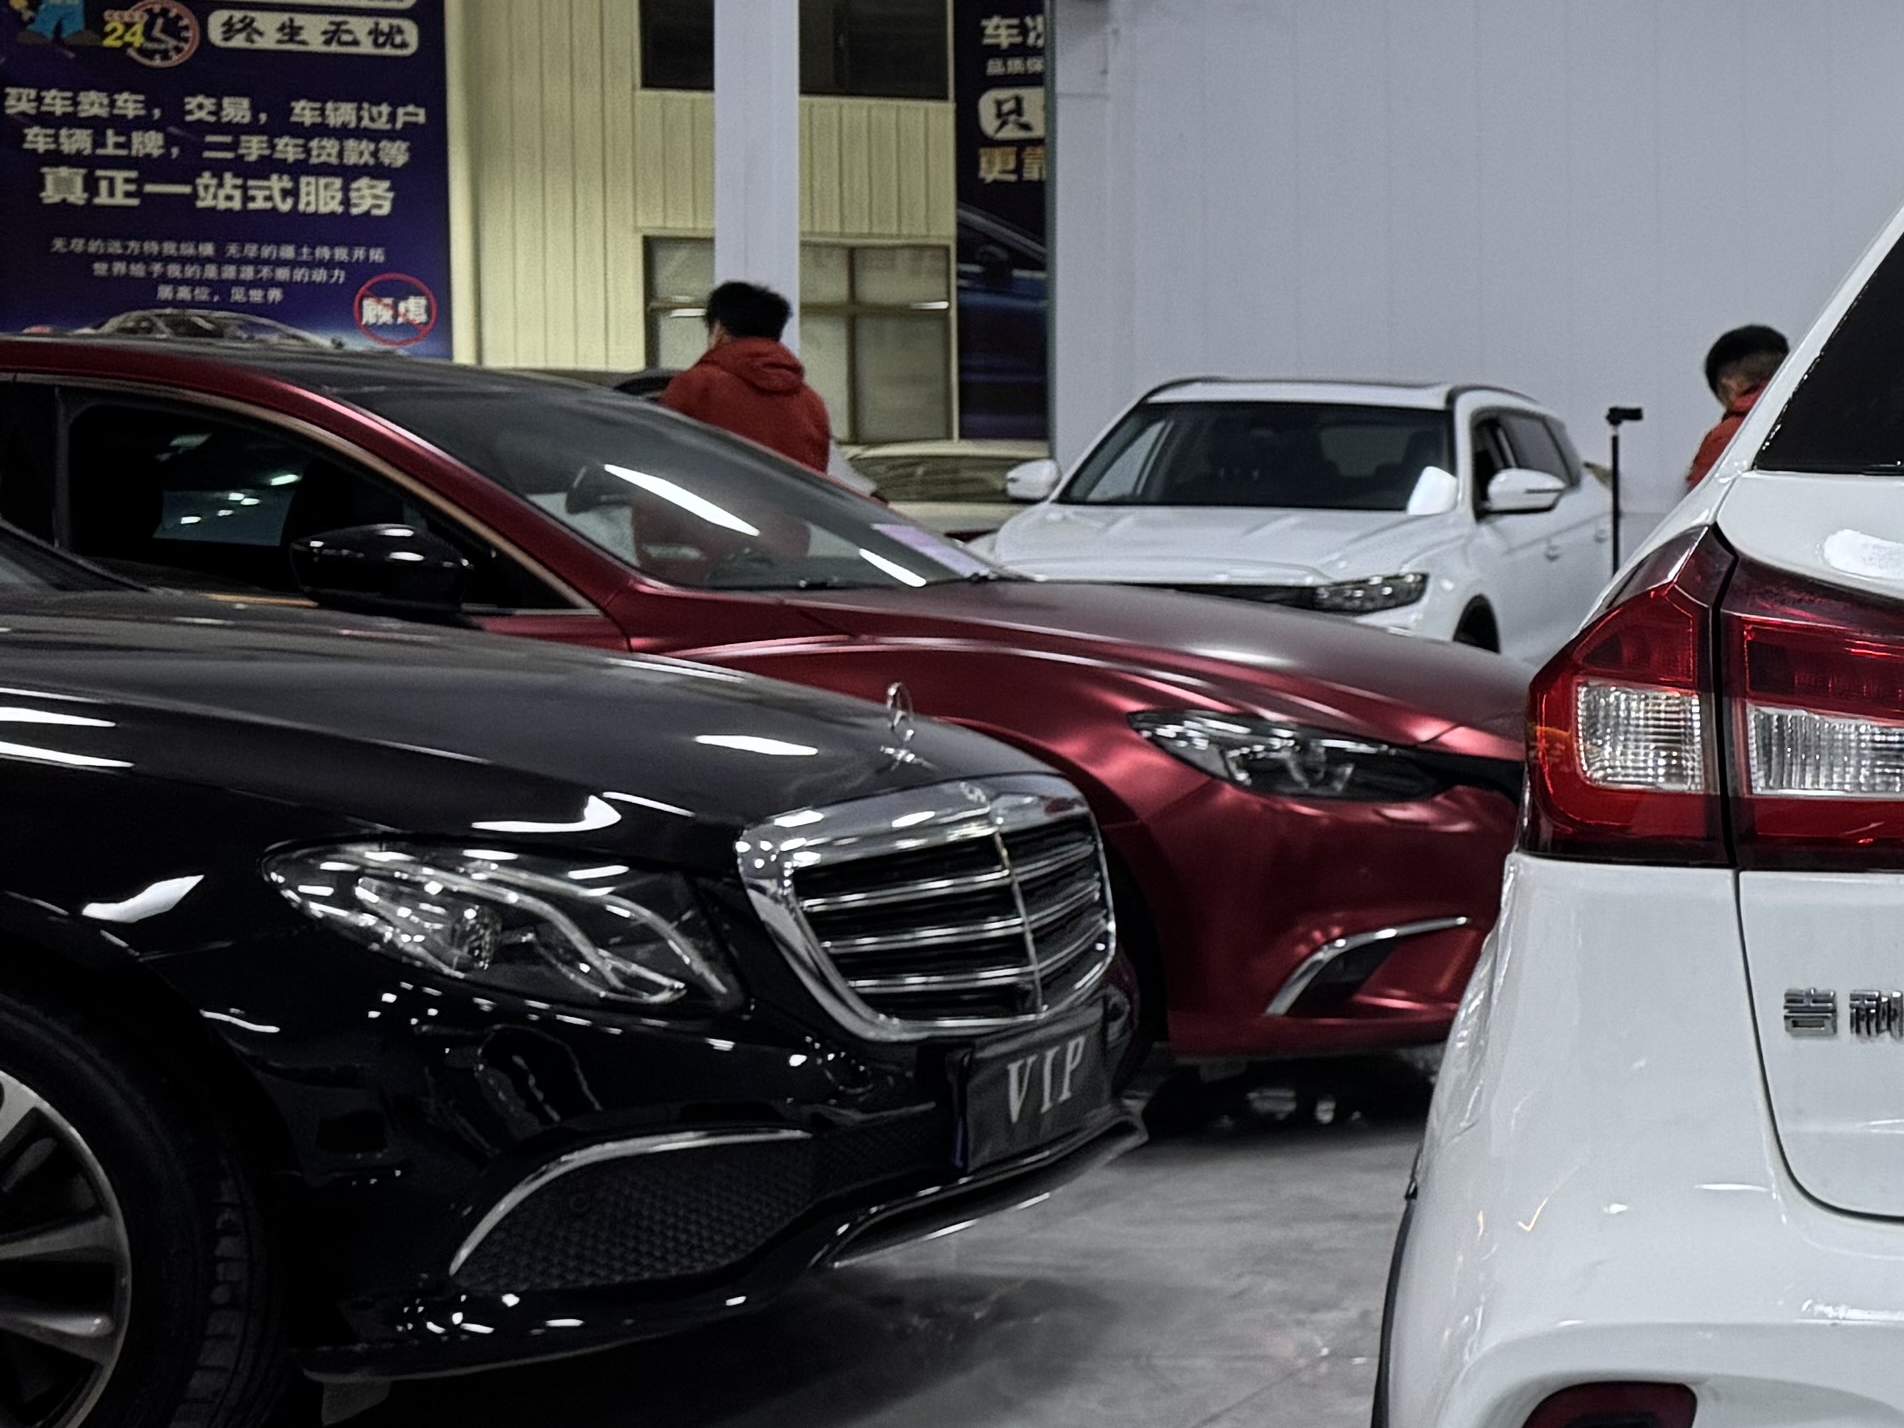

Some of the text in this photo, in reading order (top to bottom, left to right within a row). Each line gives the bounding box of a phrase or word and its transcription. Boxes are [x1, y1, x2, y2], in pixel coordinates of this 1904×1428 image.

[102, 22, 146, 48] 24
[221, 15, 410, 50] 终生无忧
[993, 94, 1033, 138] 只
[38, 165, 395, 217] 真正一站式服务
[1006, 1035, 1085, 1124] VIP
